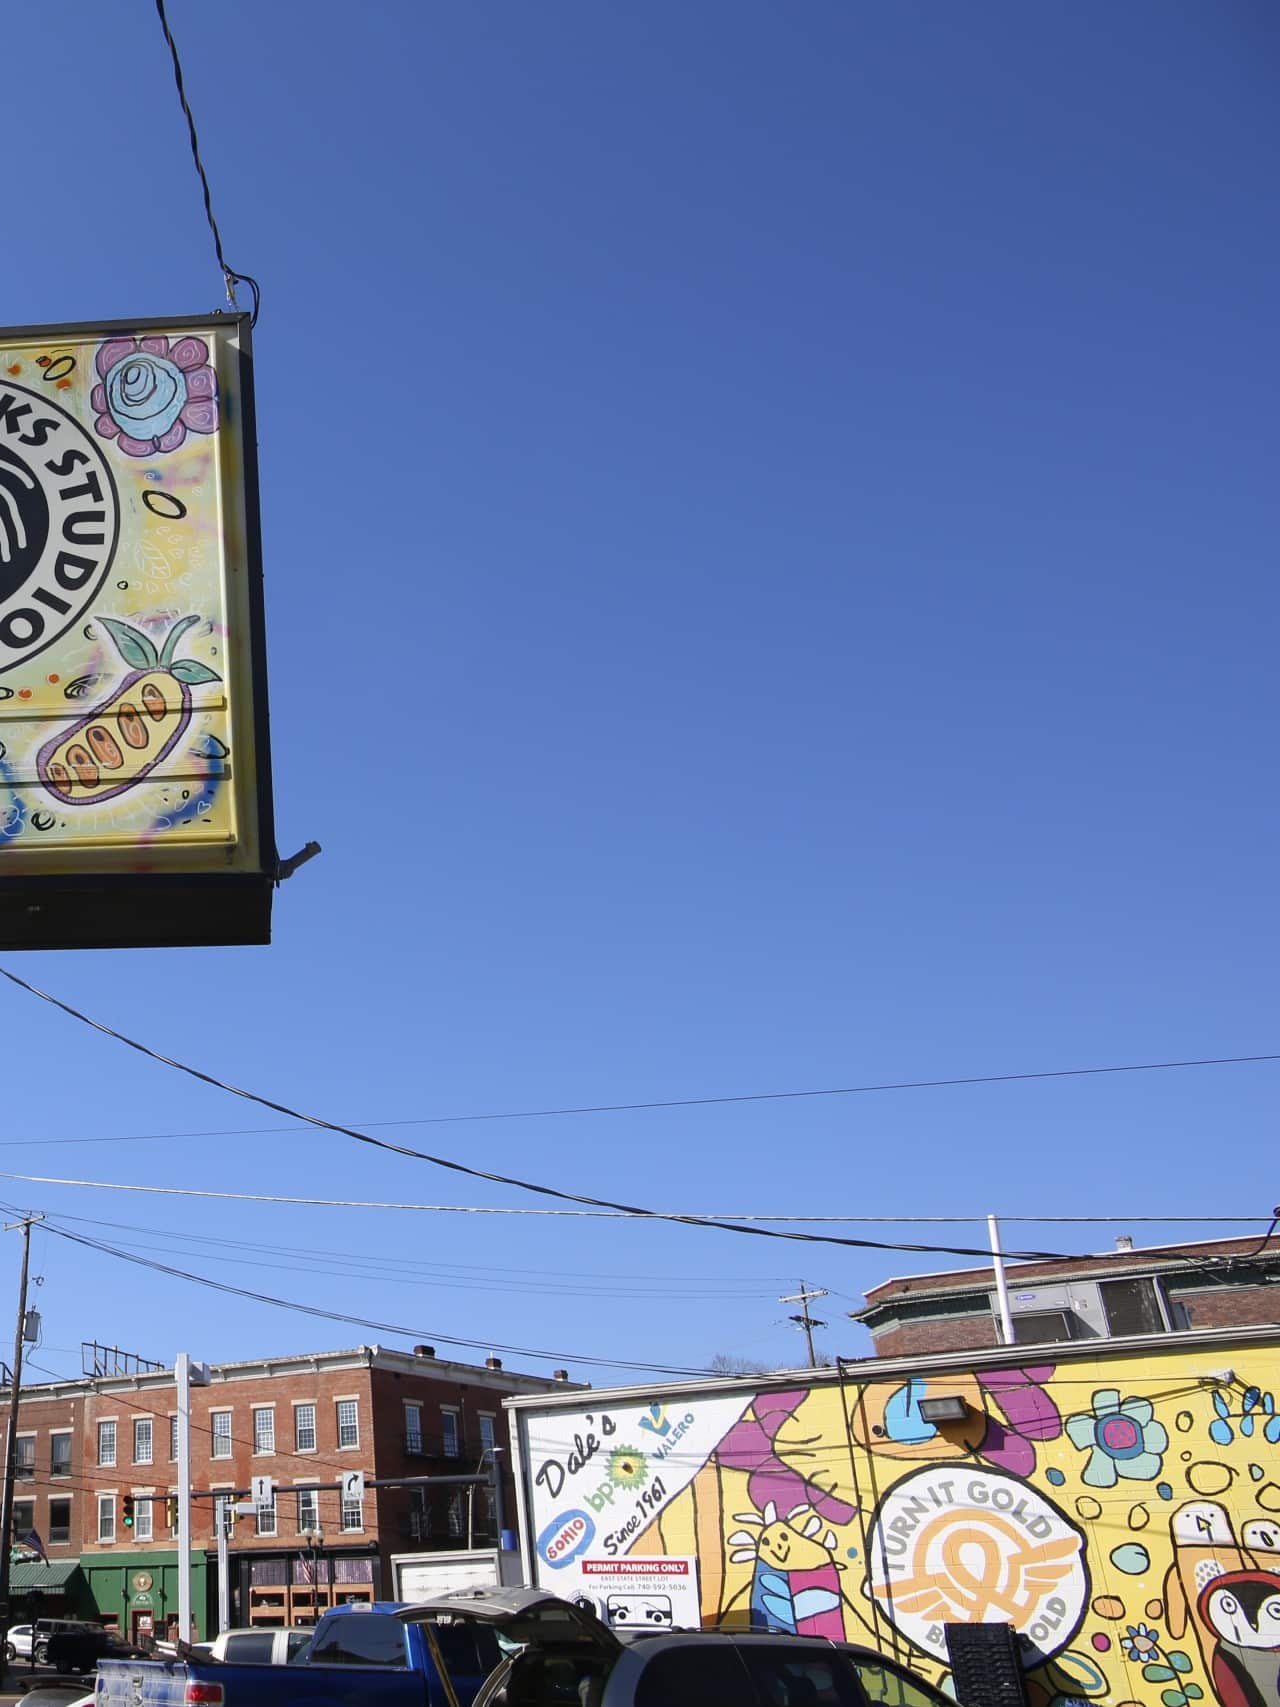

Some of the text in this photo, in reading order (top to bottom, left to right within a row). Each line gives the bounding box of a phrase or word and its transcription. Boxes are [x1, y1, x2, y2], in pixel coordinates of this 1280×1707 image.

[535, 1412, 695, 1499] Dale's VALERO
[584, 1482, 616, 1513] bp
[603, 1475, 668, 1555] Since 1961
[547, 1519, 585, 1560] SOHIO
[883, 1480, 1053, 1572] TURN IT GOLD
[587, 1563, 685, 1573] PERMIT PARKING ONLY
[1030, 1596, 1067, 1641] OLD
